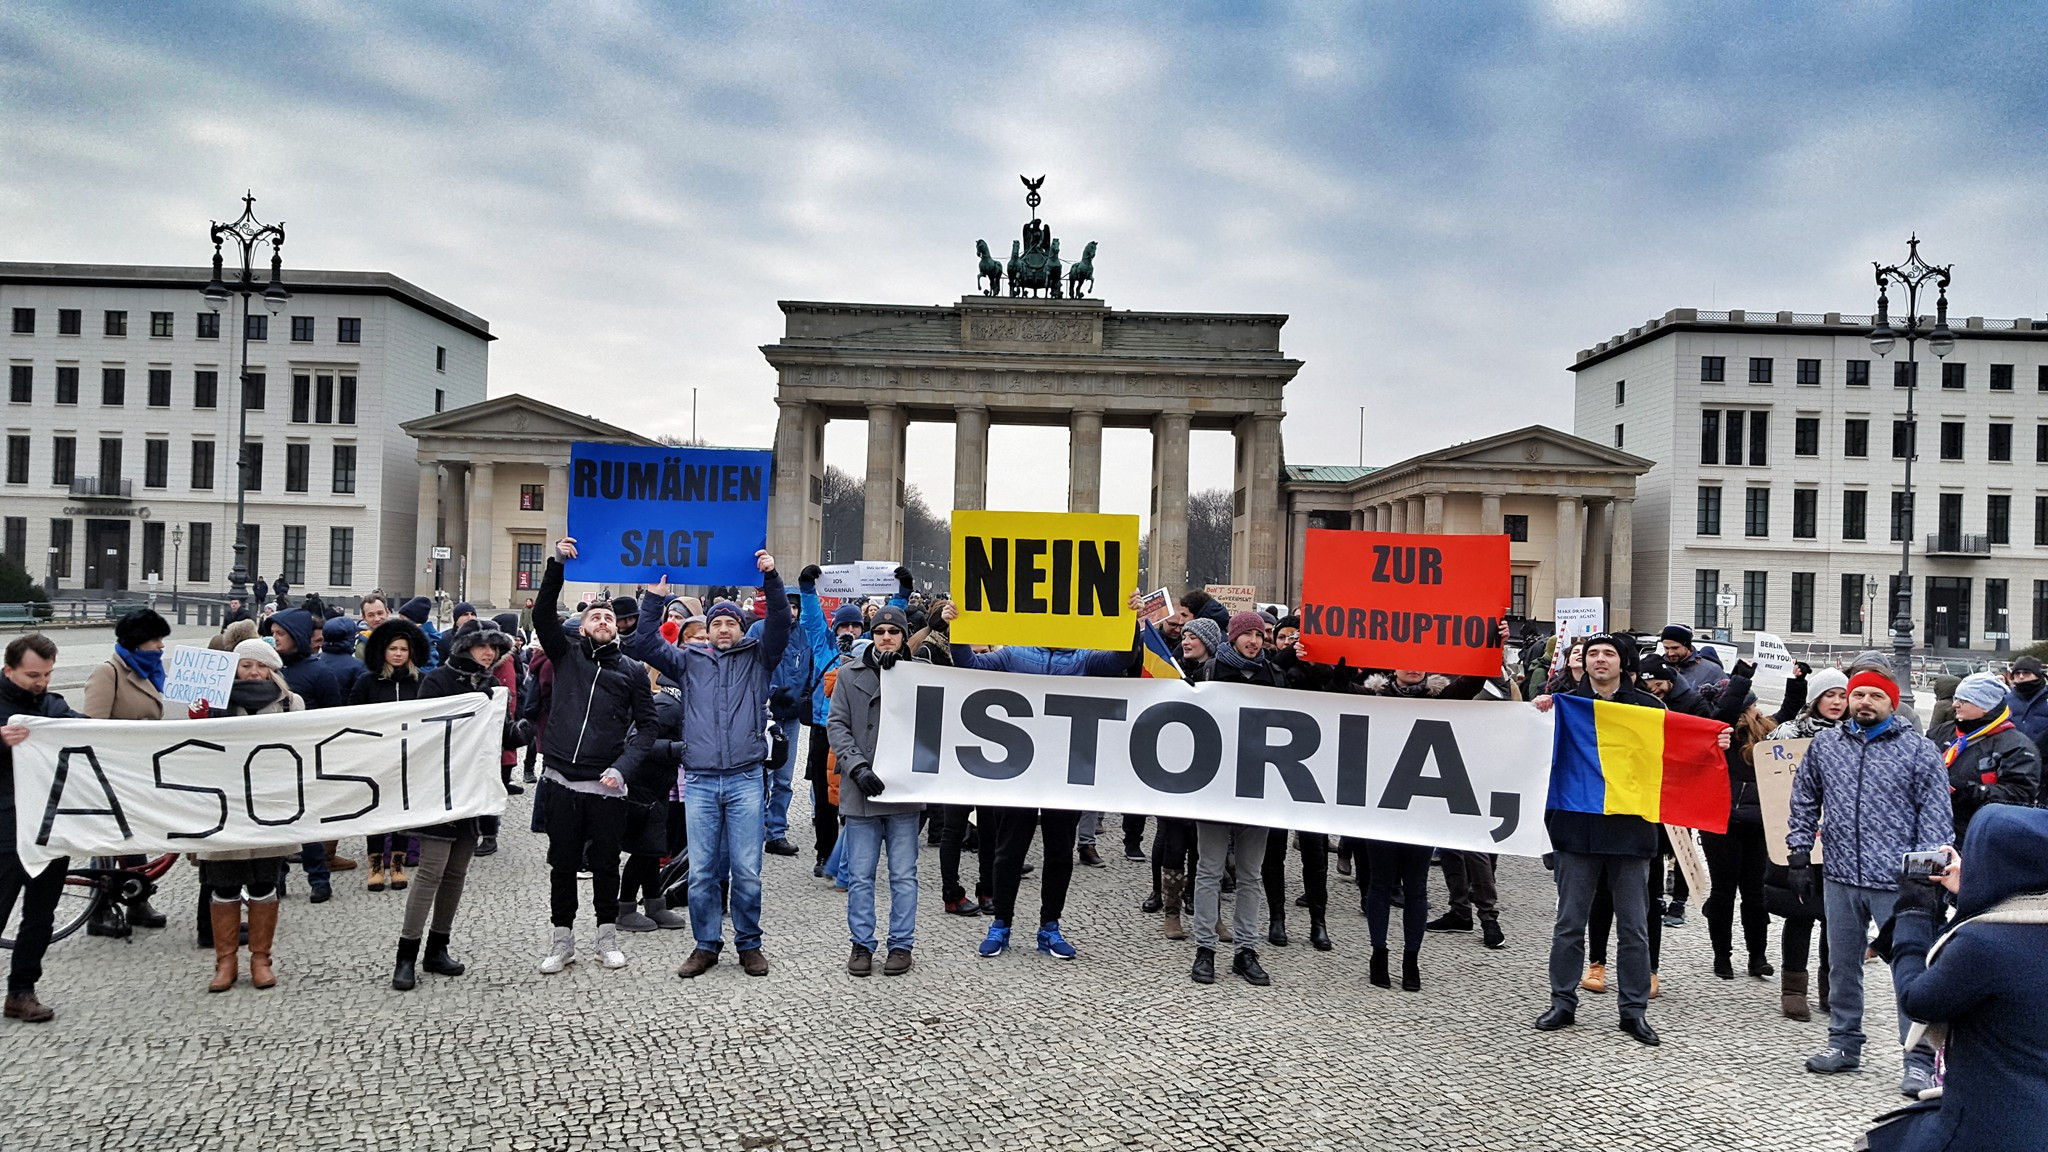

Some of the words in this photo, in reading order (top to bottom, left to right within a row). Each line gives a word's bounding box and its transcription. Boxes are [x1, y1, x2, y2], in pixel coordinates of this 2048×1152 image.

[573, 456, 763, 502] RUMÄNIEN
[620, 529, 715, 568] SAGT
[1371, 544, 1443, 586] ZUR
[964, 535, 1121, 617] NEIN
[1303, 603, 1502, 649] KORRUPTION
[1760, 640, 1783, 650] BERLIN
[174, 649, 229, 672] UNITED
[1758, 651, 1775, 660] WITH
[164, 682, 227, 706] CORRUPTION
[174, 668, 227, 686] AGAINST
[911, 685, 1521, 844] ISTORIA,
